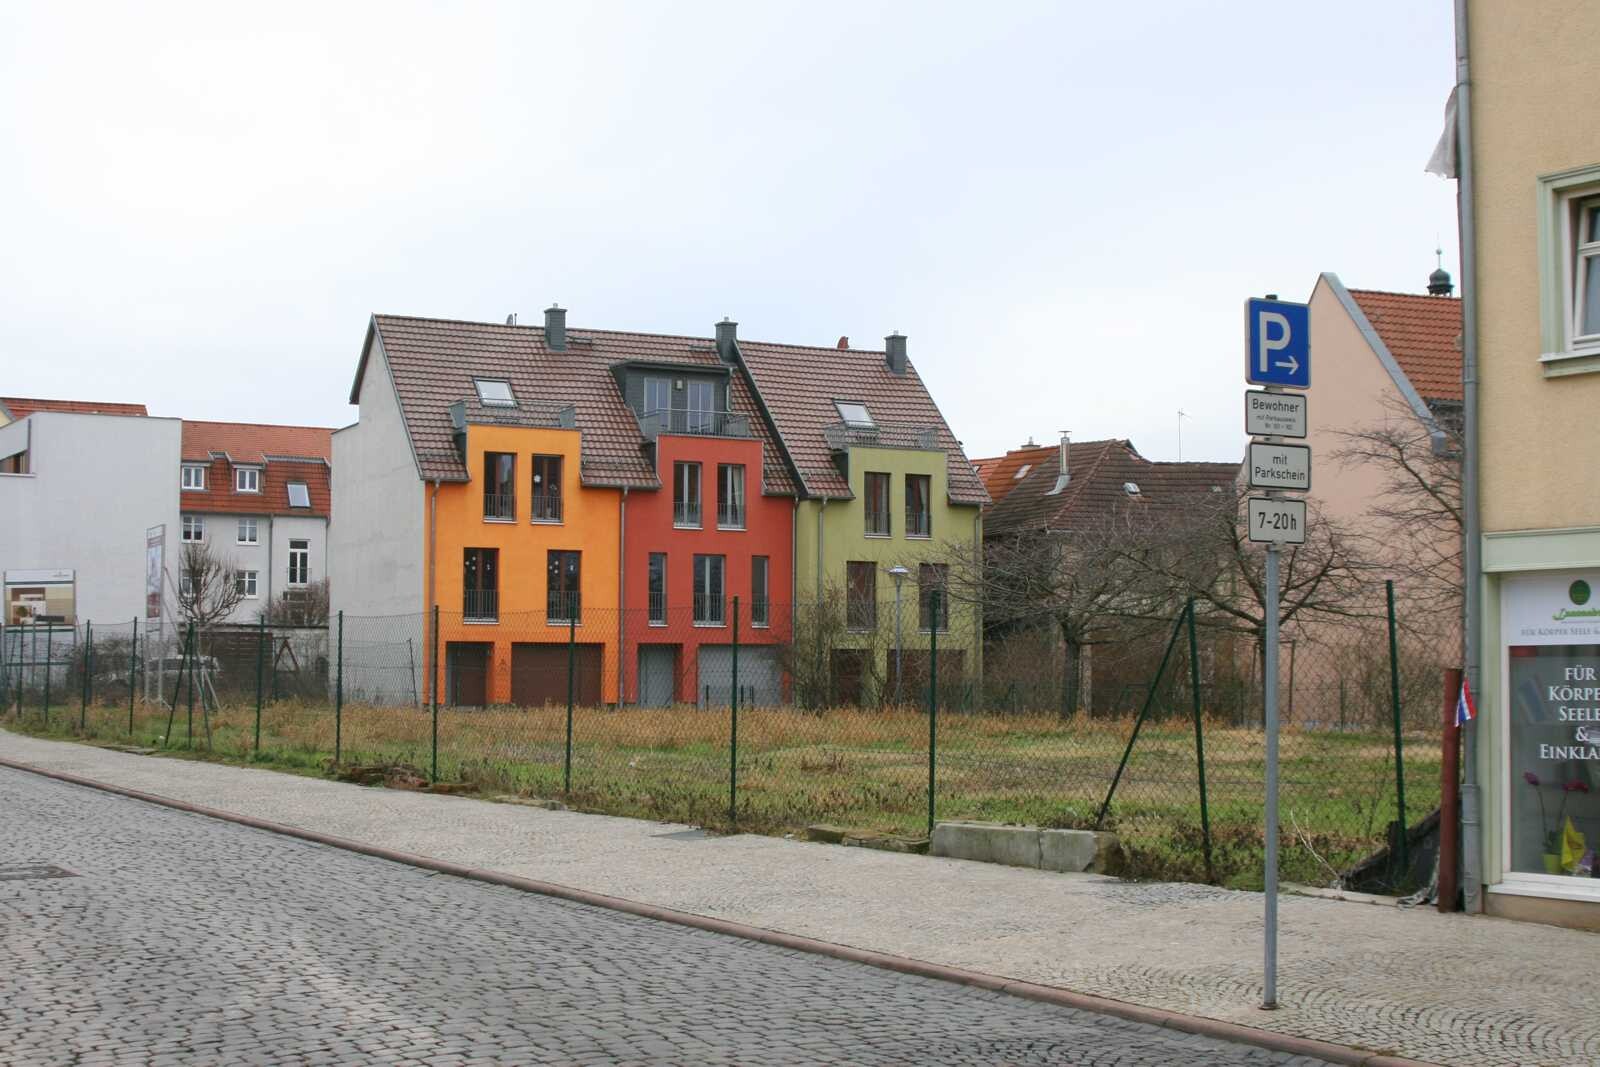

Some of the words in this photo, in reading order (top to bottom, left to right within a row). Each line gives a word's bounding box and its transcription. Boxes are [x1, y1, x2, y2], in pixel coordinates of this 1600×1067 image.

[1259, 311, 1292, 373] P
[1252, 398, 1299, 413] Bewohner
[1272, 455, 1288, 465] mit
[1255, 466, 1305, 481] Parkschein
[1565, 664, 1597, 681] FÜR
[1559, 706, 1600, 721] SEELE
[1575, 726, 1590, 742] &
[1540, 743, 1600, 760] EINKLA
